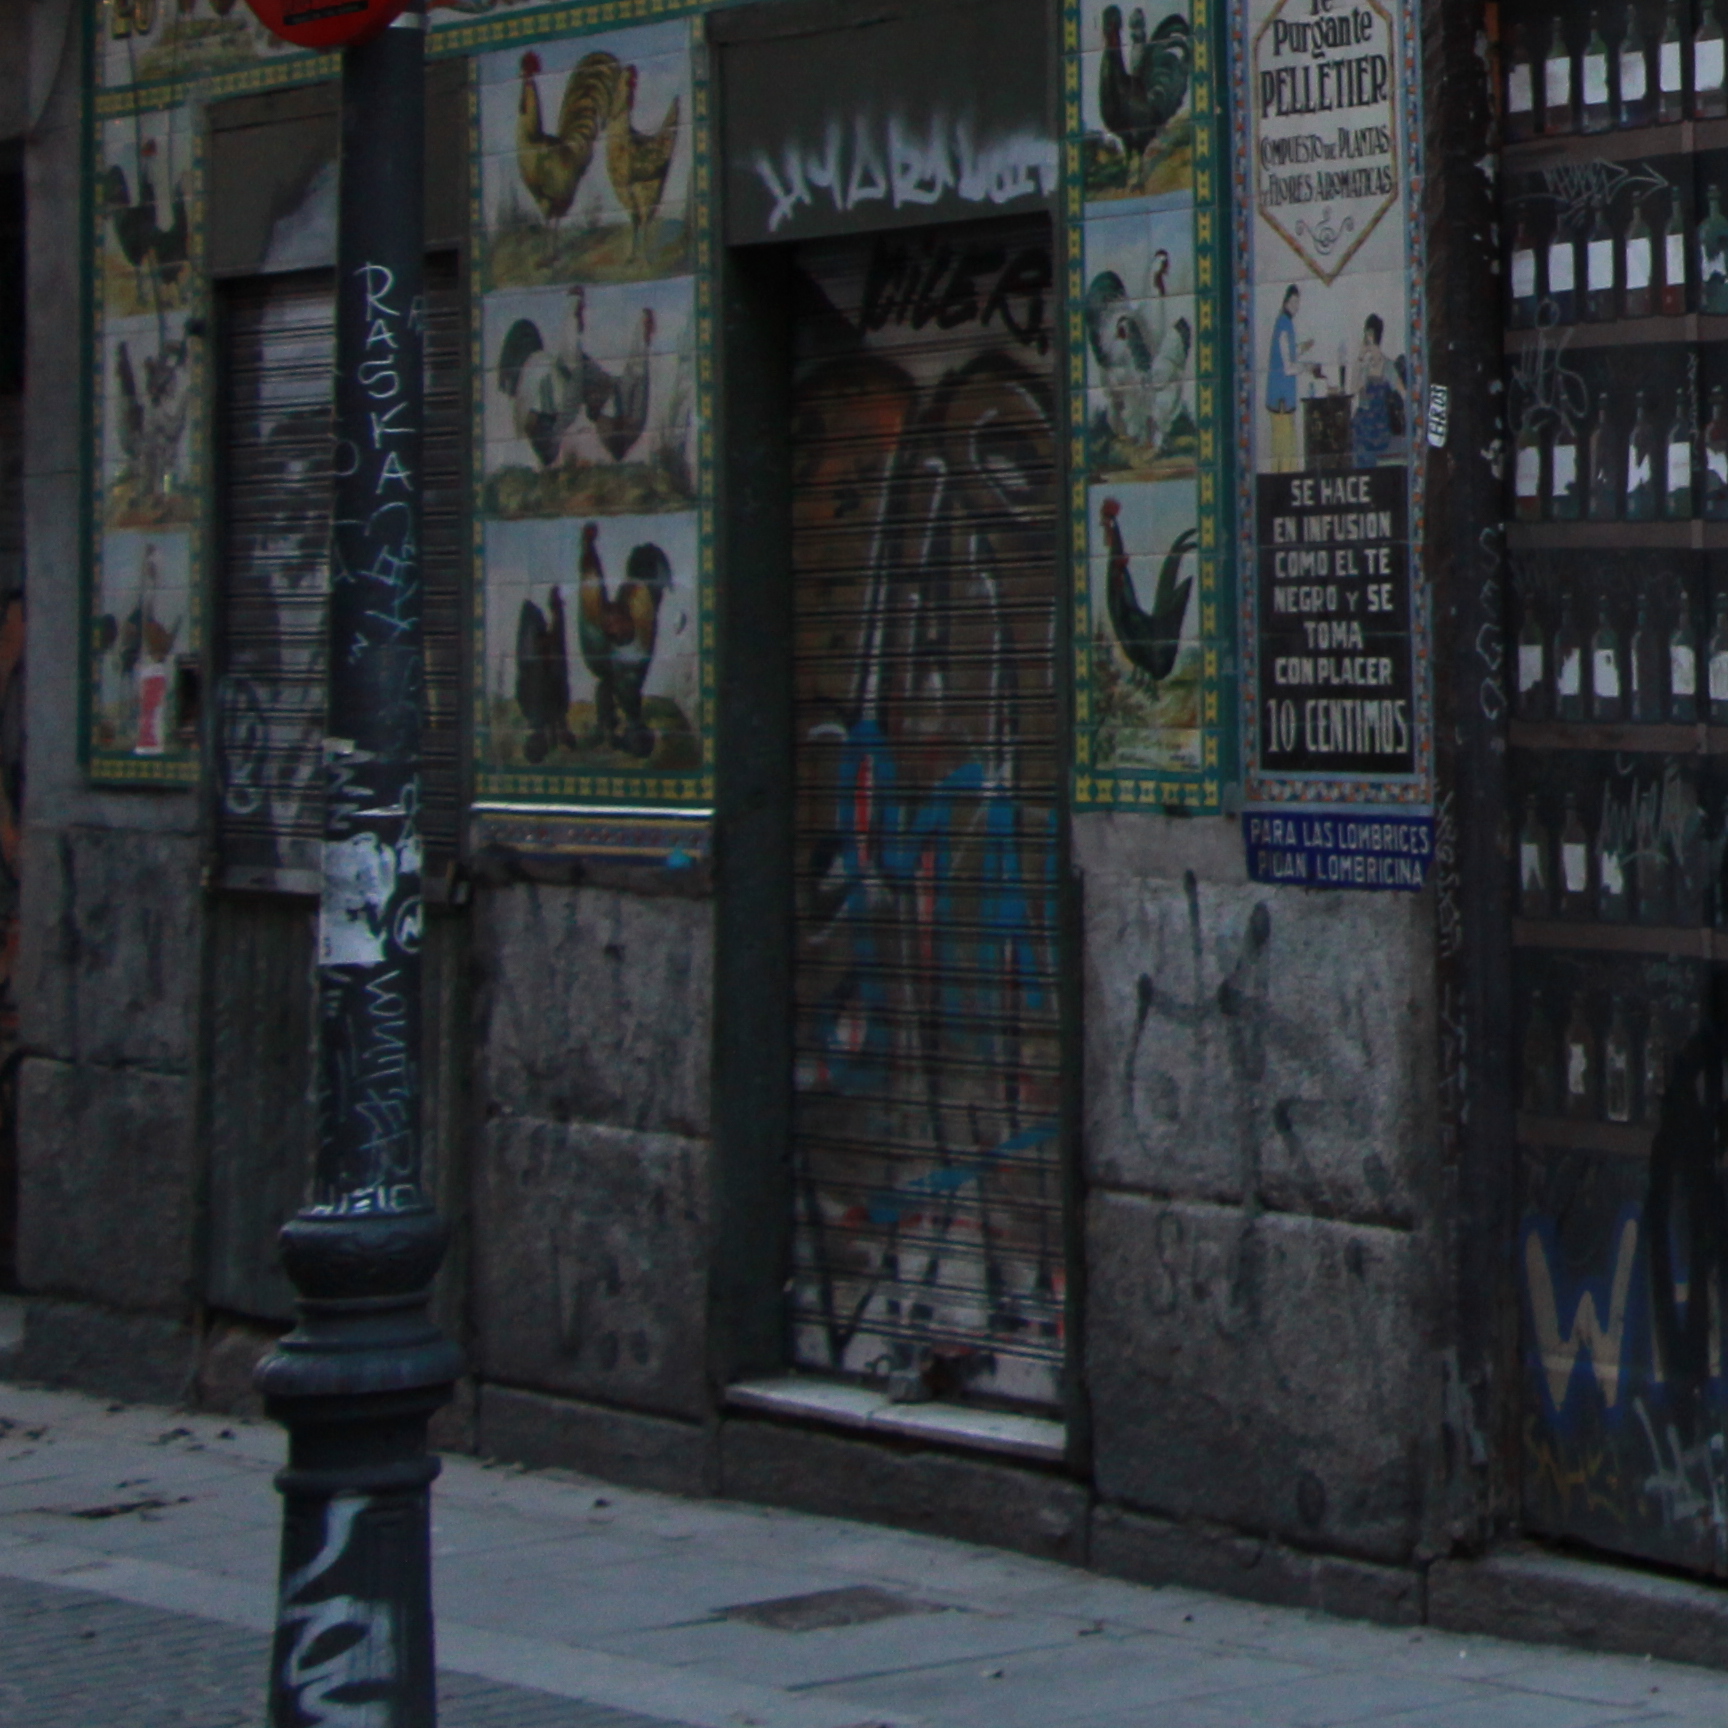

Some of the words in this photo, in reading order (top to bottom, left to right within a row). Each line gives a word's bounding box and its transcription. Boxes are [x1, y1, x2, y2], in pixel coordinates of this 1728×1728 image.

[1273, 8, 1373, 59] Purgante
[1291, 478, 1316, 507] SE
[1320, 475, 1372, 506] HACE
[1273, 516, 1298, 544] EN
[1302, 511, 1392, 543] INFUSION
[1275, 550, 1330, 578] COMO
[1334, 549, 1359, 577] EL
[1364, 548, 1392, 576] TE
[1273, 585, 1338, 613] NEGRO
[1366, 582, 1394, 612] SE
[1302, 620, 1363, 650] TOMA
[1275, 657, 1315, 686] CON
[1316, 656, 1393, 686] PLACER
[1266, 698, 1298, 754] 10
[1304, 698, 1410, 755] CENTIMOS
[1249, 818, 1297, 846] PARA
[1302, 820, 1334, 849] LAS
[1337, 822, 1432, 855] LOMBRICES
